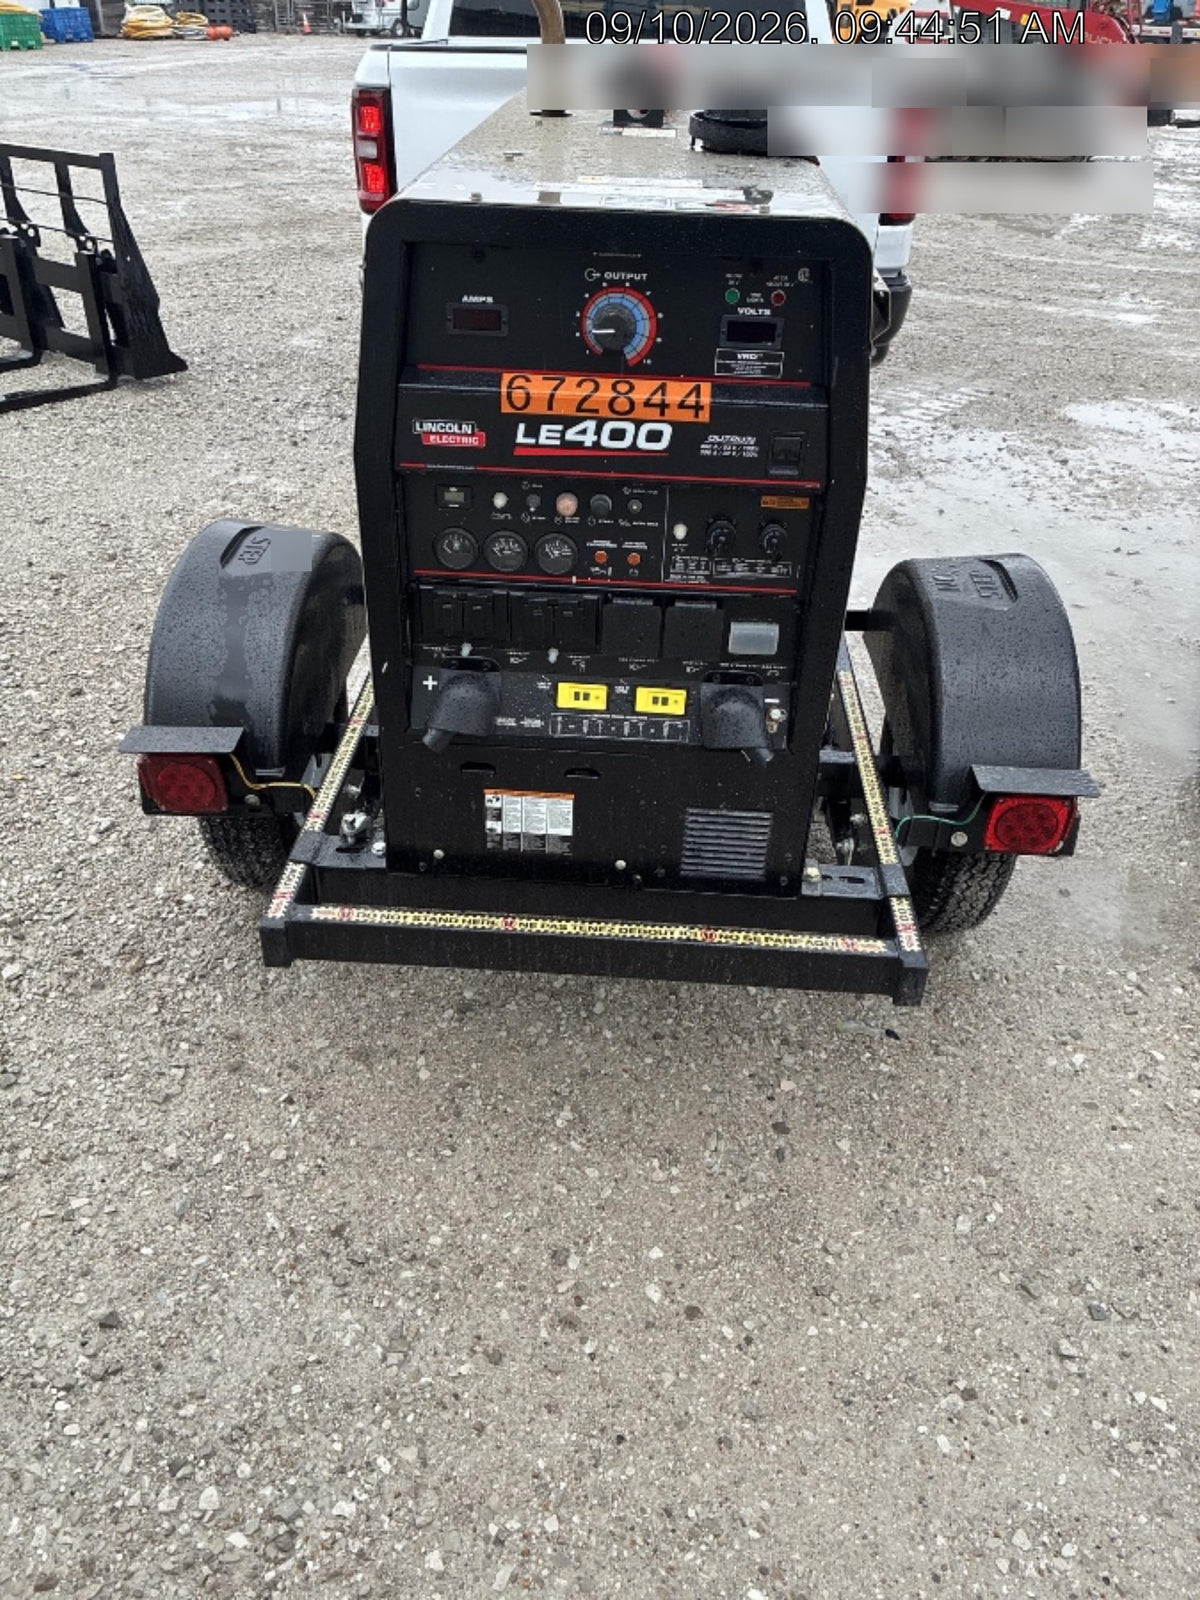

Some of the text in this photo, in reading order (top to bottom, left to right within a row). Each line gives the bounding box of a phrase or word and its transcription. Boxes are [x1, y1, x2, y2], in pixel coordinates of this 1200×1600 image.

[603, 271, 648, 280] OUTPUT
[461, 294, 494, 303] AMPS
[737, 307, 772, 316] VOLTS
[505, 374, 706, 419] 672844
[415, 420, 472, 434] LINCOLN
[429, 434, 479, 445] ELECTRIC
[514, 419, 673, 451] LE400
[411, 914, 460, 925] STAND
